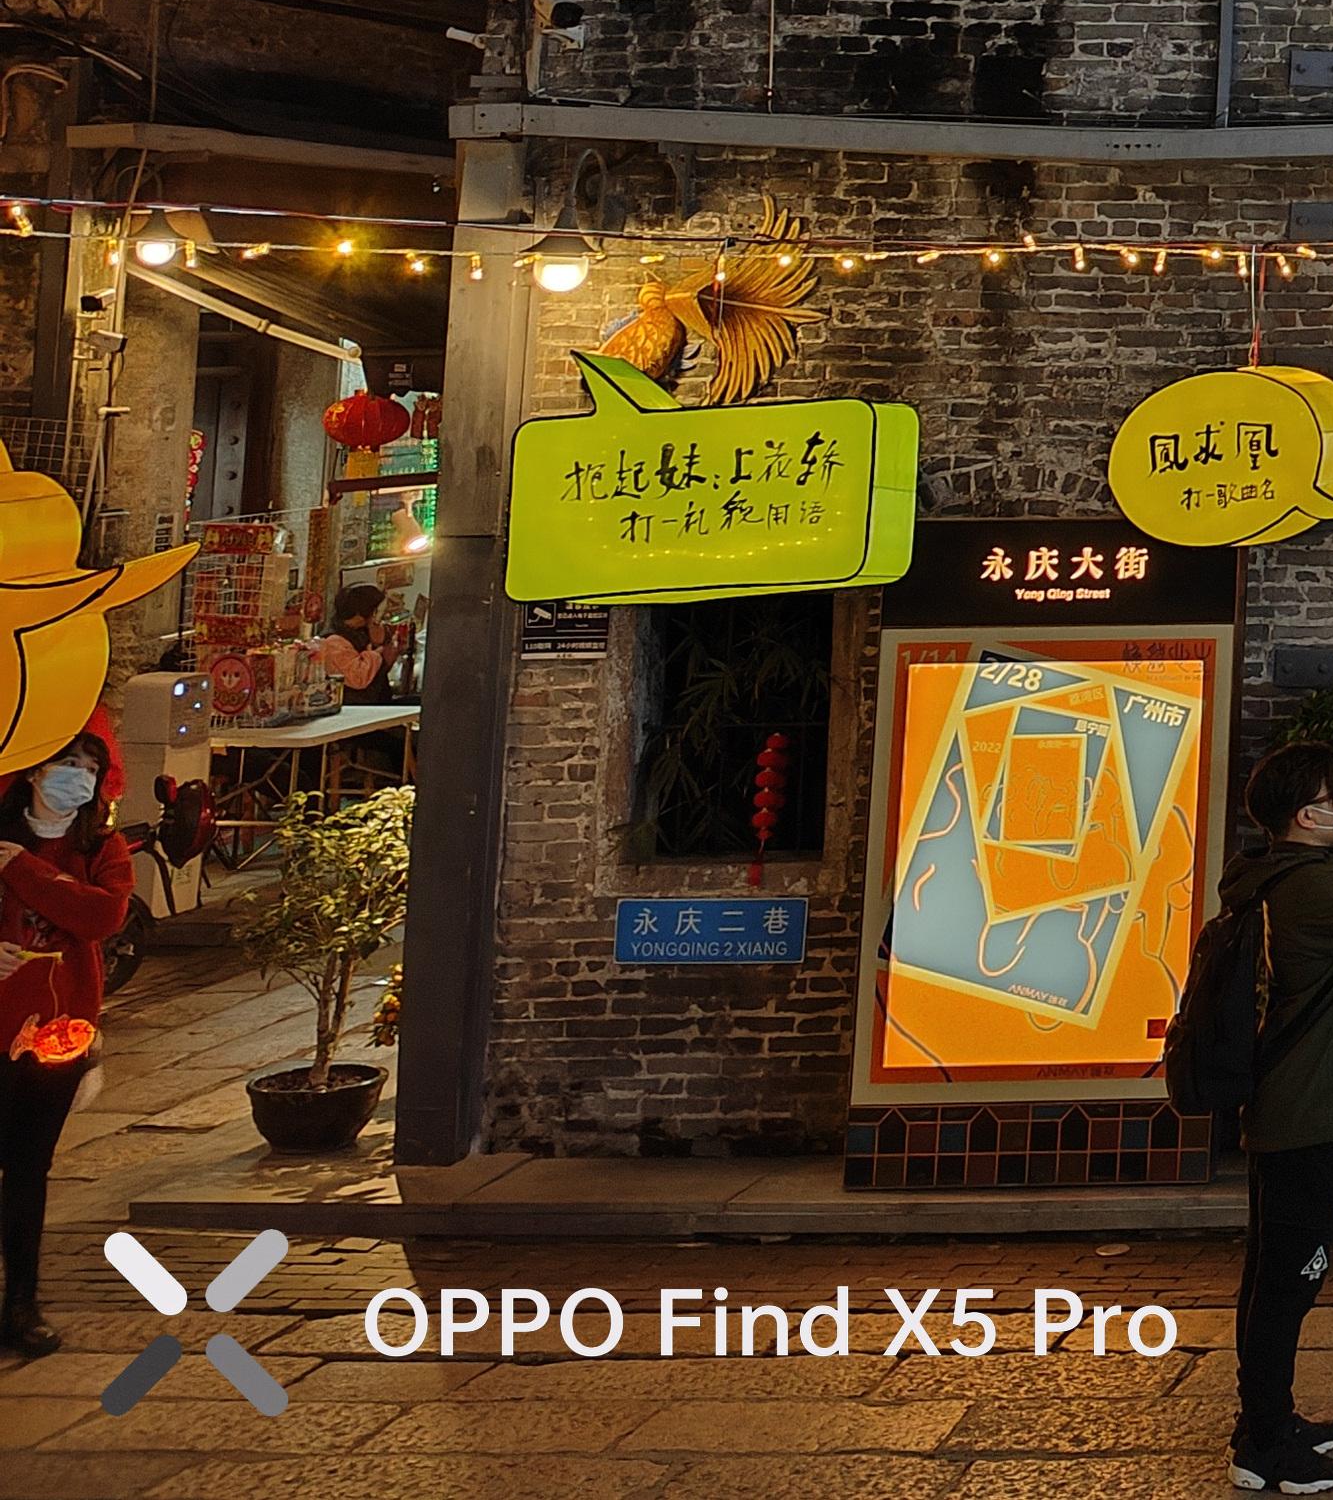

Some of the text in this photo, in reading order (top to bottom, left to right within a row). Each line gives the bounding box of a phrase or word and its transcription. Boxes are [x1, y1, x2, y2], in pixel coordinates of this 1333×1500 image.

[979, 546, 1150, 582] 永庆大街
[979, 656, 1043, 692] 2/28
[1123, 694, 1186, 728] 广州市
[972, 741, 1002, 754] 2022
[633, 907, 790, 936] 永庆二巷
[631, 941, 788, 957] YONGQING 2 XIANG
